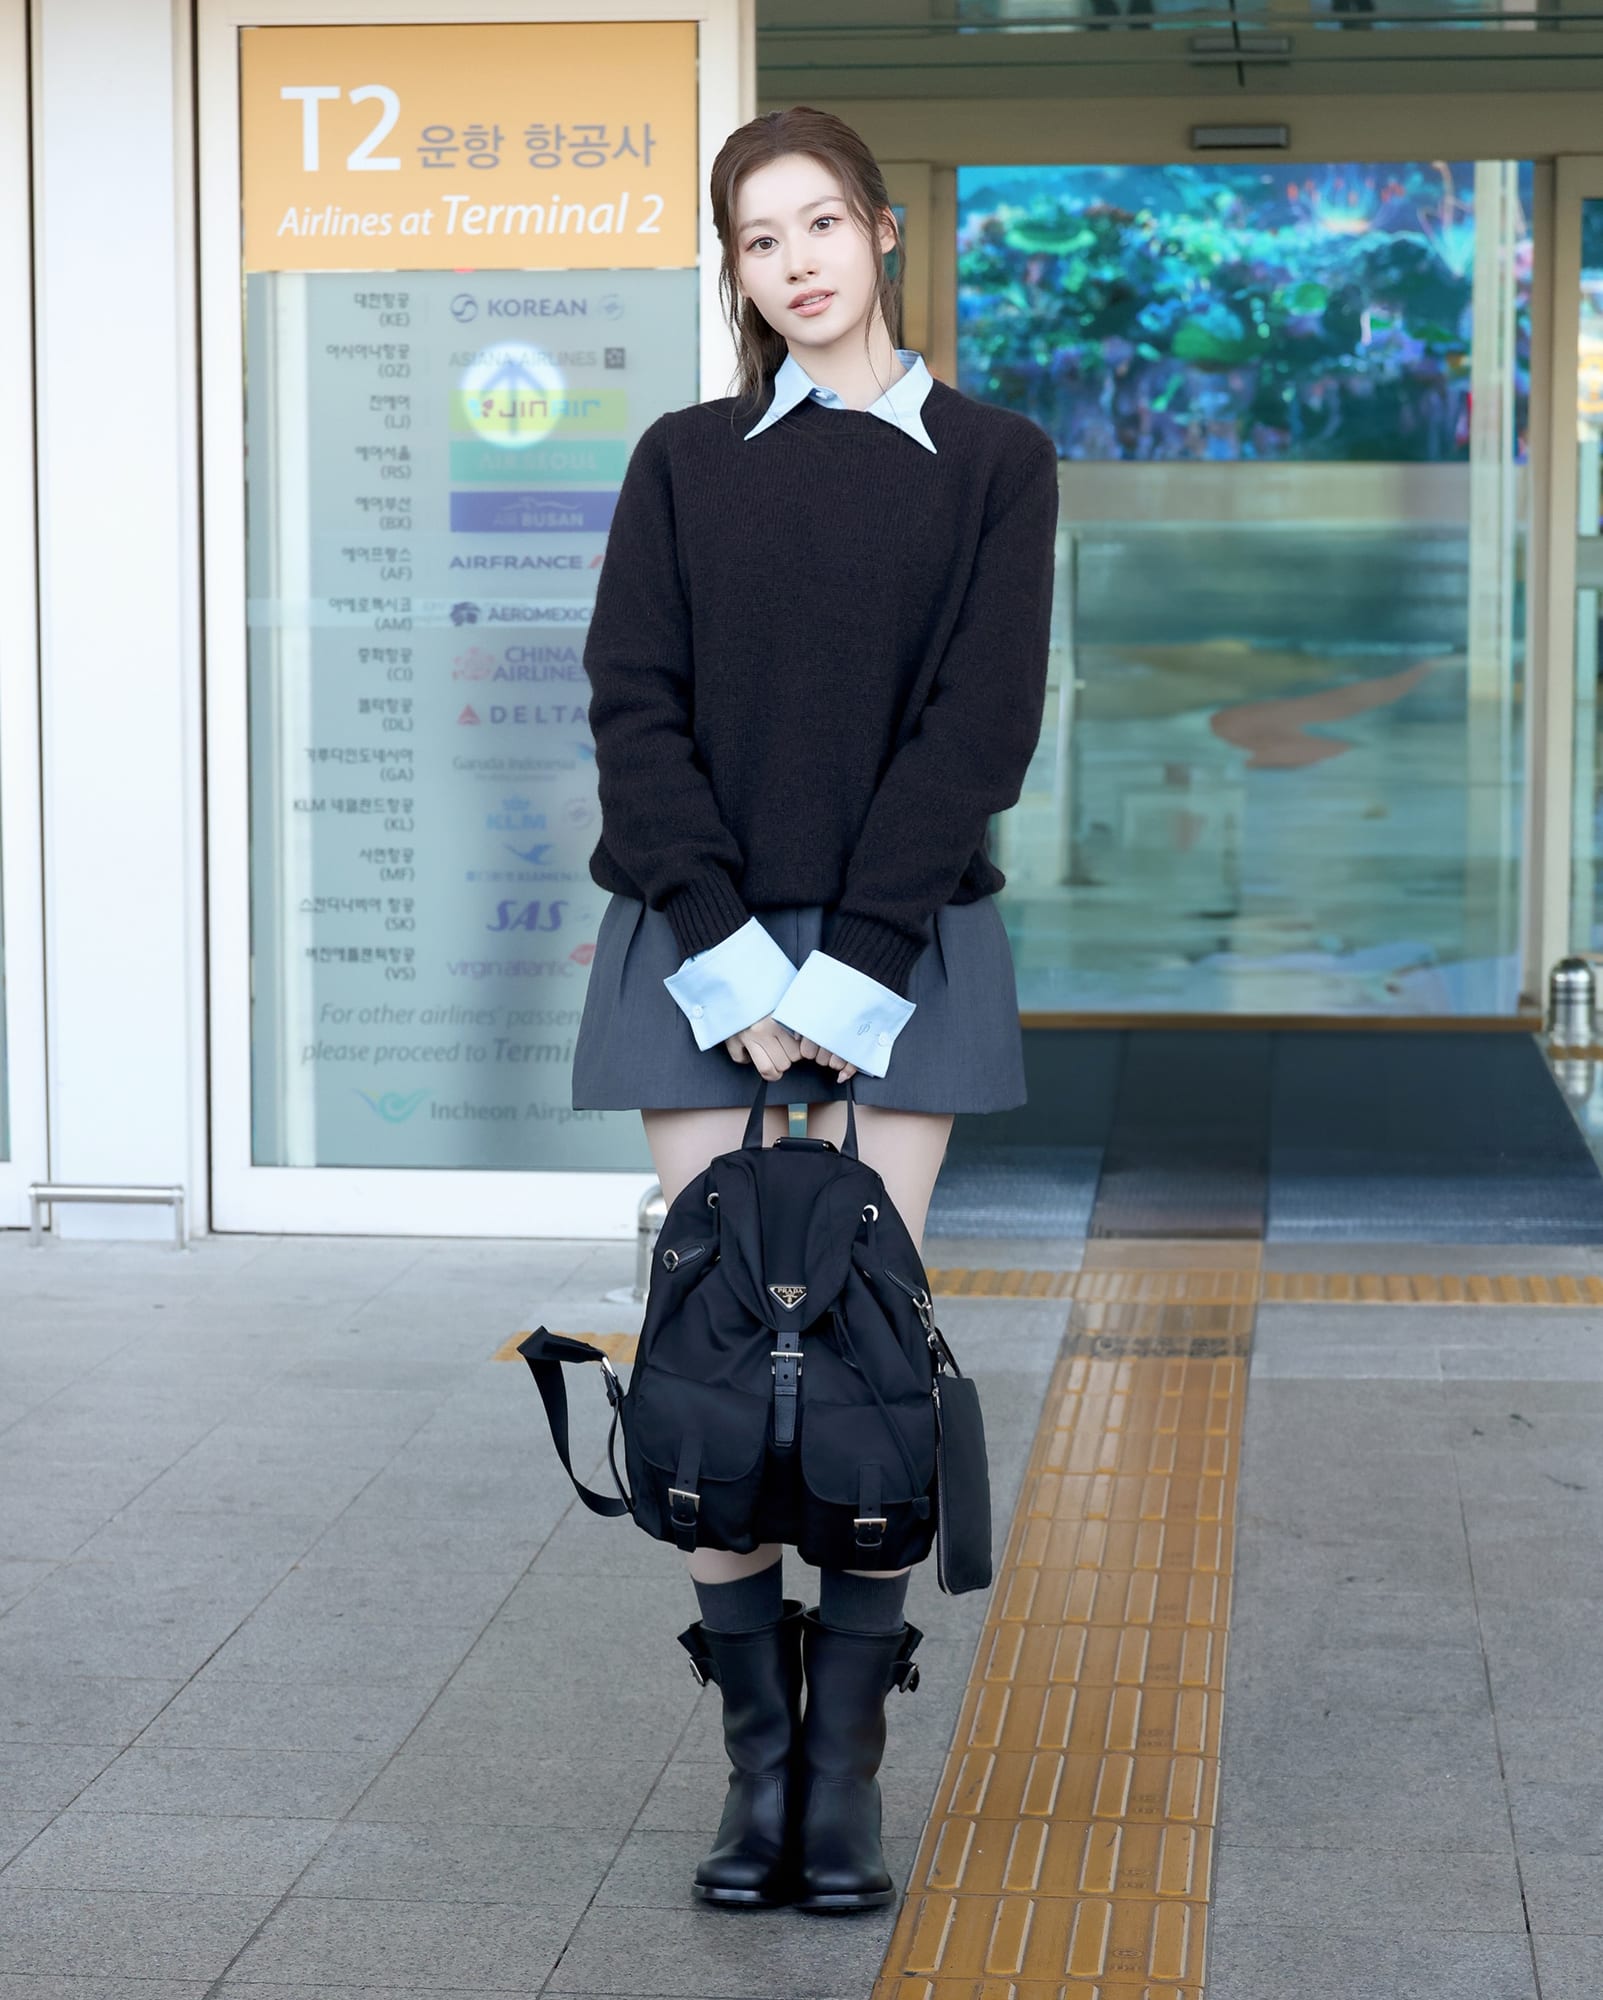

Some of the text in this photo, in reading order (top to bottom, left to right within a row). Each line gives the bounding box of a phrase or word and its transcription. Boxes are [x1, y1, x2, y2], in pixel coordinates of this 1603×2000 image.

[280, 84, 401, 172] T2
[416, 122, 656, 169] 운항 항공사
[277, 192, 664, 236] Airlines at Terminal 2
[487, 298, 587, 317] KOREAN
[379, 312, 411, 328] (KE)
[378, 363, 411, 379] (OZ)
[384, 414, 411, 430] (LJ)
[380, 464, 412, 480] (RS)
[521, 512, 584, 527] BUSAN
[449, 554, 582, 570] AIRFRANCE
[380, 566, 412, 582] (AF)
[488, 606, 592, 623] AEROMEXIC
[375, 616, 413, 632] (AM)
[505, 645, 577, 664] CHINA
[387, 667, 414, 682] (CI)
[490, 704, 587, 725] DELTA
[382, 717, 414, 733] (DL)
[380, 767, 414, 783] (GA)
[293, 798, 326, 813] KLM
[384, 817, 415, 832] (KL)
[380, 867, 415, 882] (MF)
[486, 898, 569, 932] SAS
[384, 916, 416, 932] (SK)
[384, 966, 416, 982] (VS)
[320, 1002, 354, 1024] For
[358, 1002, 414, 1025] other
[506, 1007, 581, 1029] passen
[301, 1037, 573, 1066] please proceed to Termi
[430, 1101, 518, 1121] Incheon
